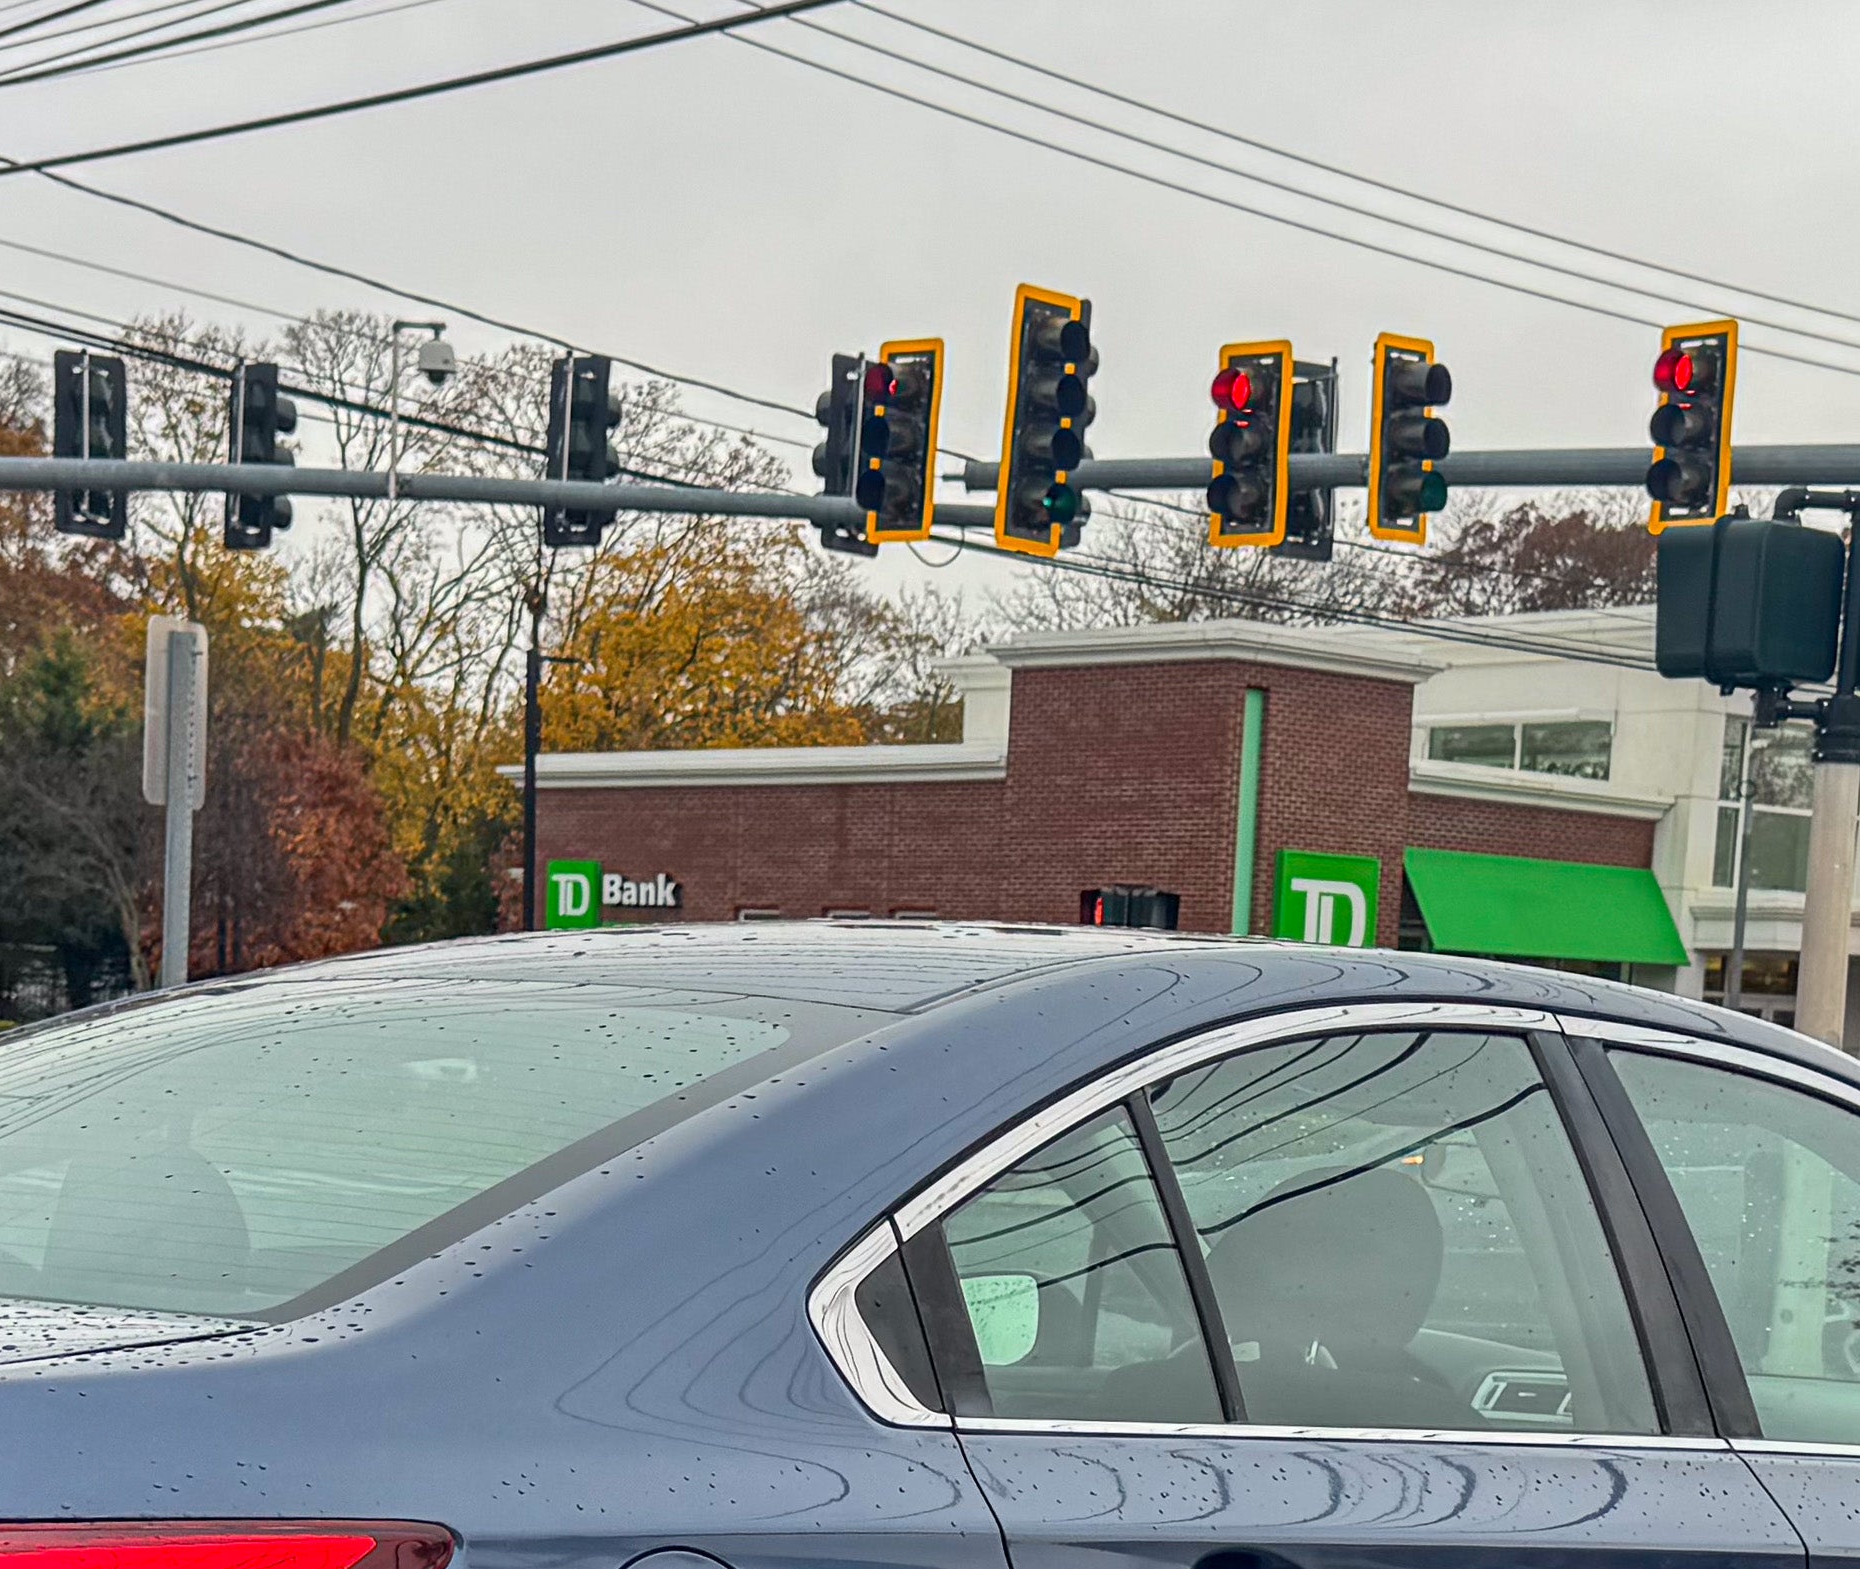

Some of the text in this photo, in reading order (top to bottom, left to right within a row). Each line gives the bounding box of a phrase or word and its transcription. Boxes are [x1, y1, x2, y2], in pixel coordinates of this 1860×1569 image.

[551, 873, 676, 916] TD Bank
[1290, 877, 1366, 947] TD
